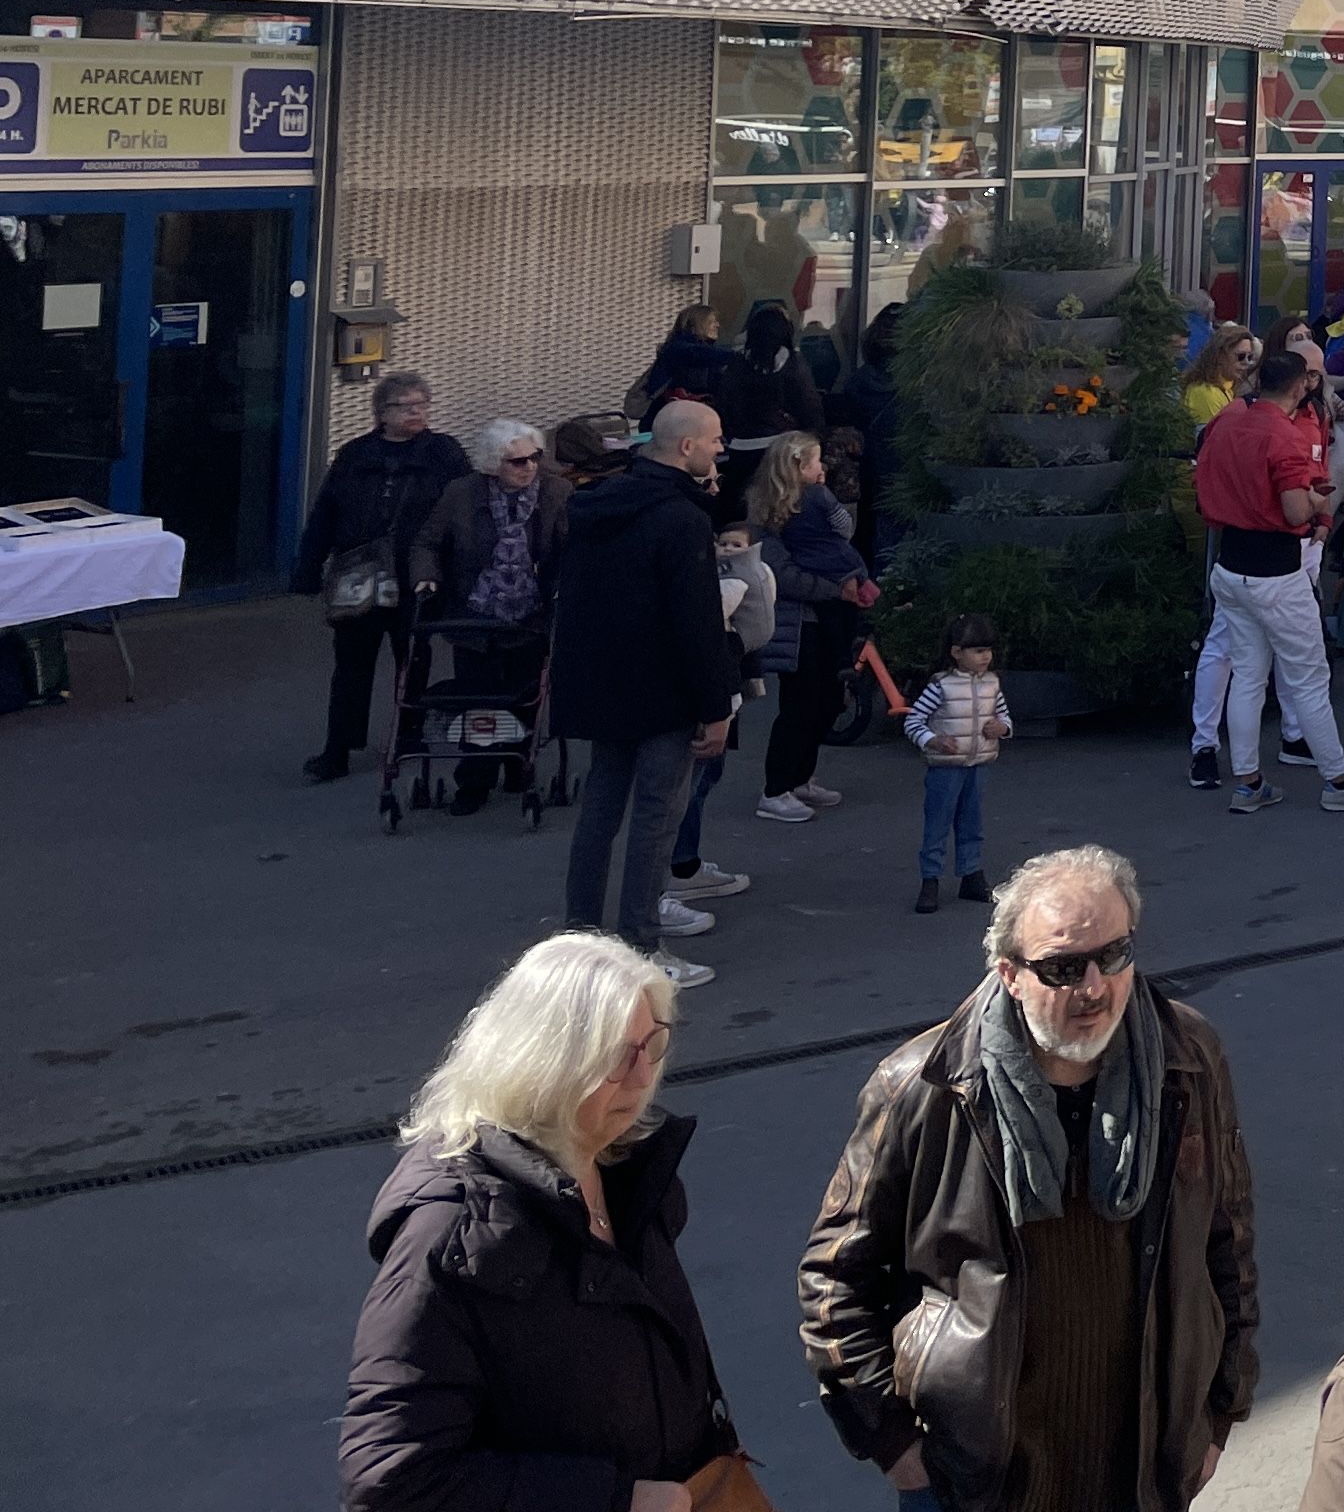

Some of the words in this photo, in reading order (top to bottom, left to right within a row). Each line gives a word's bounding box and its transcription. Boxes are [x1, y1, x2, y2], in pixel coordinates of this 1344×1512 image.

[80, 68, 204, 87] APARCAMENT
[52, 96, 142, 116] MERCAT
[146, 98, 173, 116] DE
[179, 98, 226, 116] RUBI
[107, 129, 168, 150] Parkia
